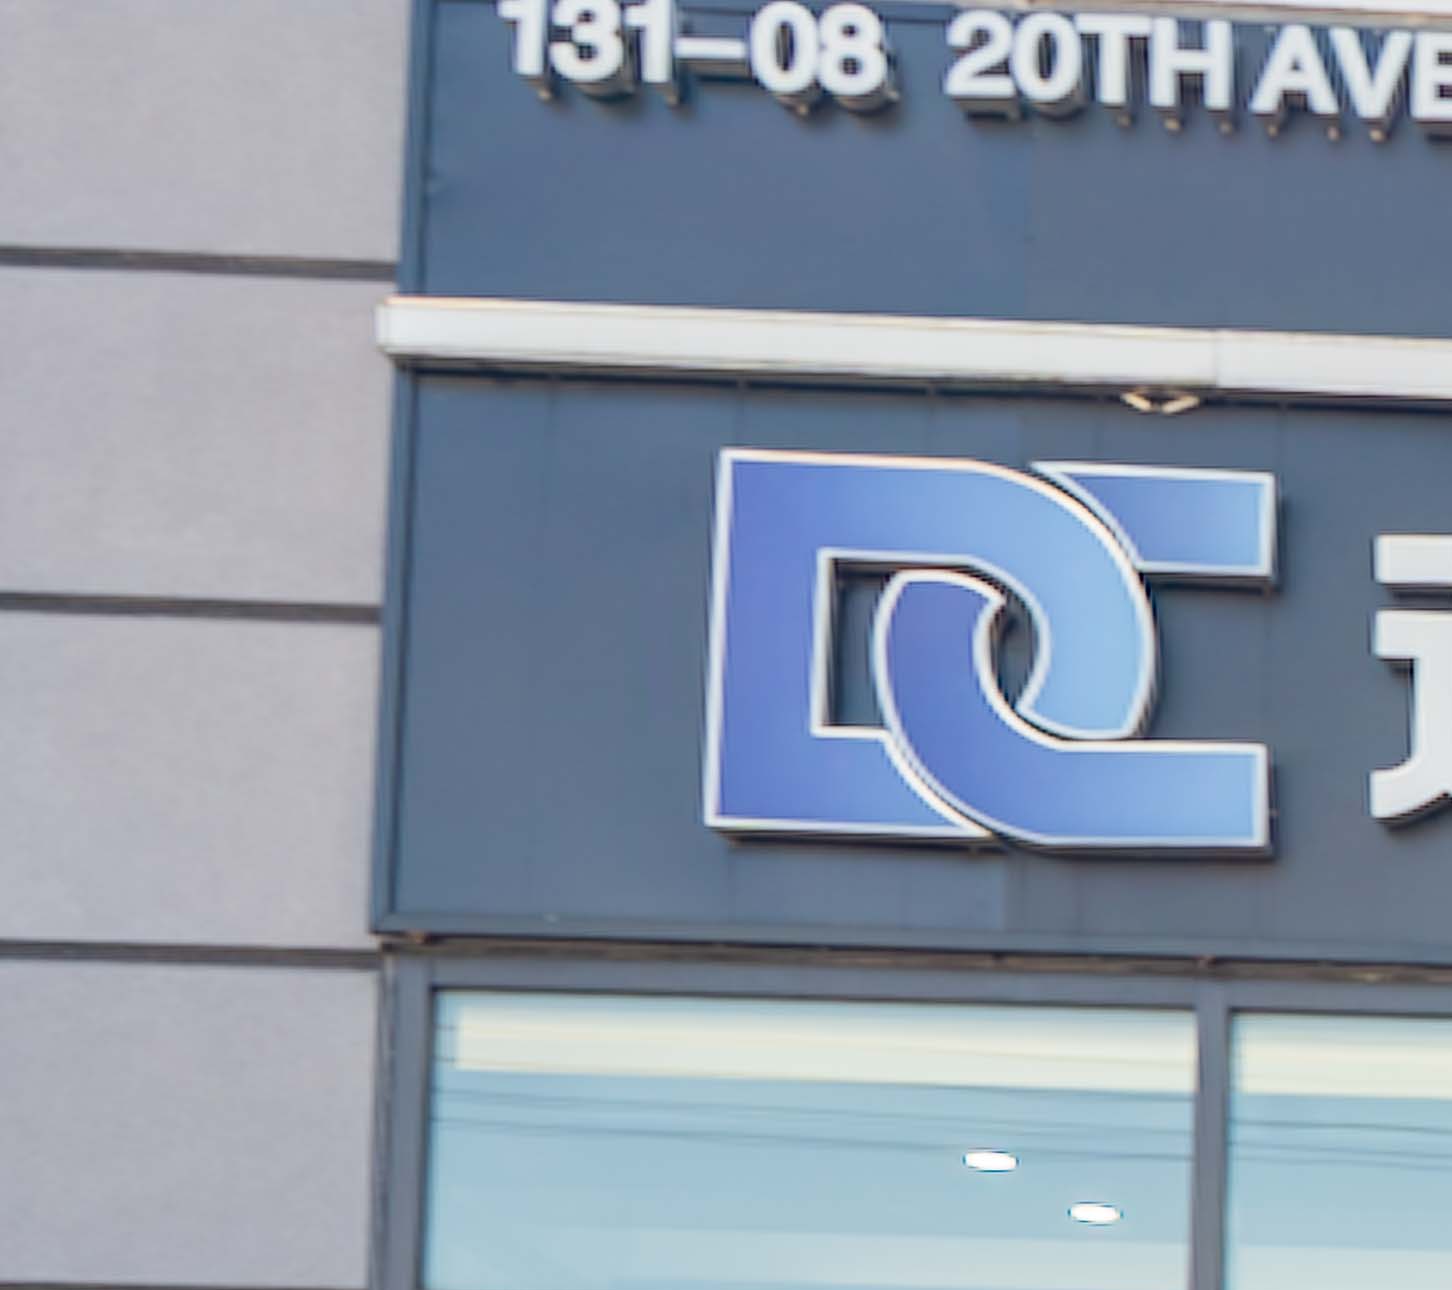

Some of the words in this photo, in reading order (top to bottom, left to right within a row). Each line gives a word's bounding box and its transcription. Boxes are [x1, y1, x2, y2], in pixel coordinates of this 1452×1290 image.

[498, 0, 890, 97] 131-08
[942, 10, 1234, 112] 20TH
[704, 446, 1276, 850] DC
